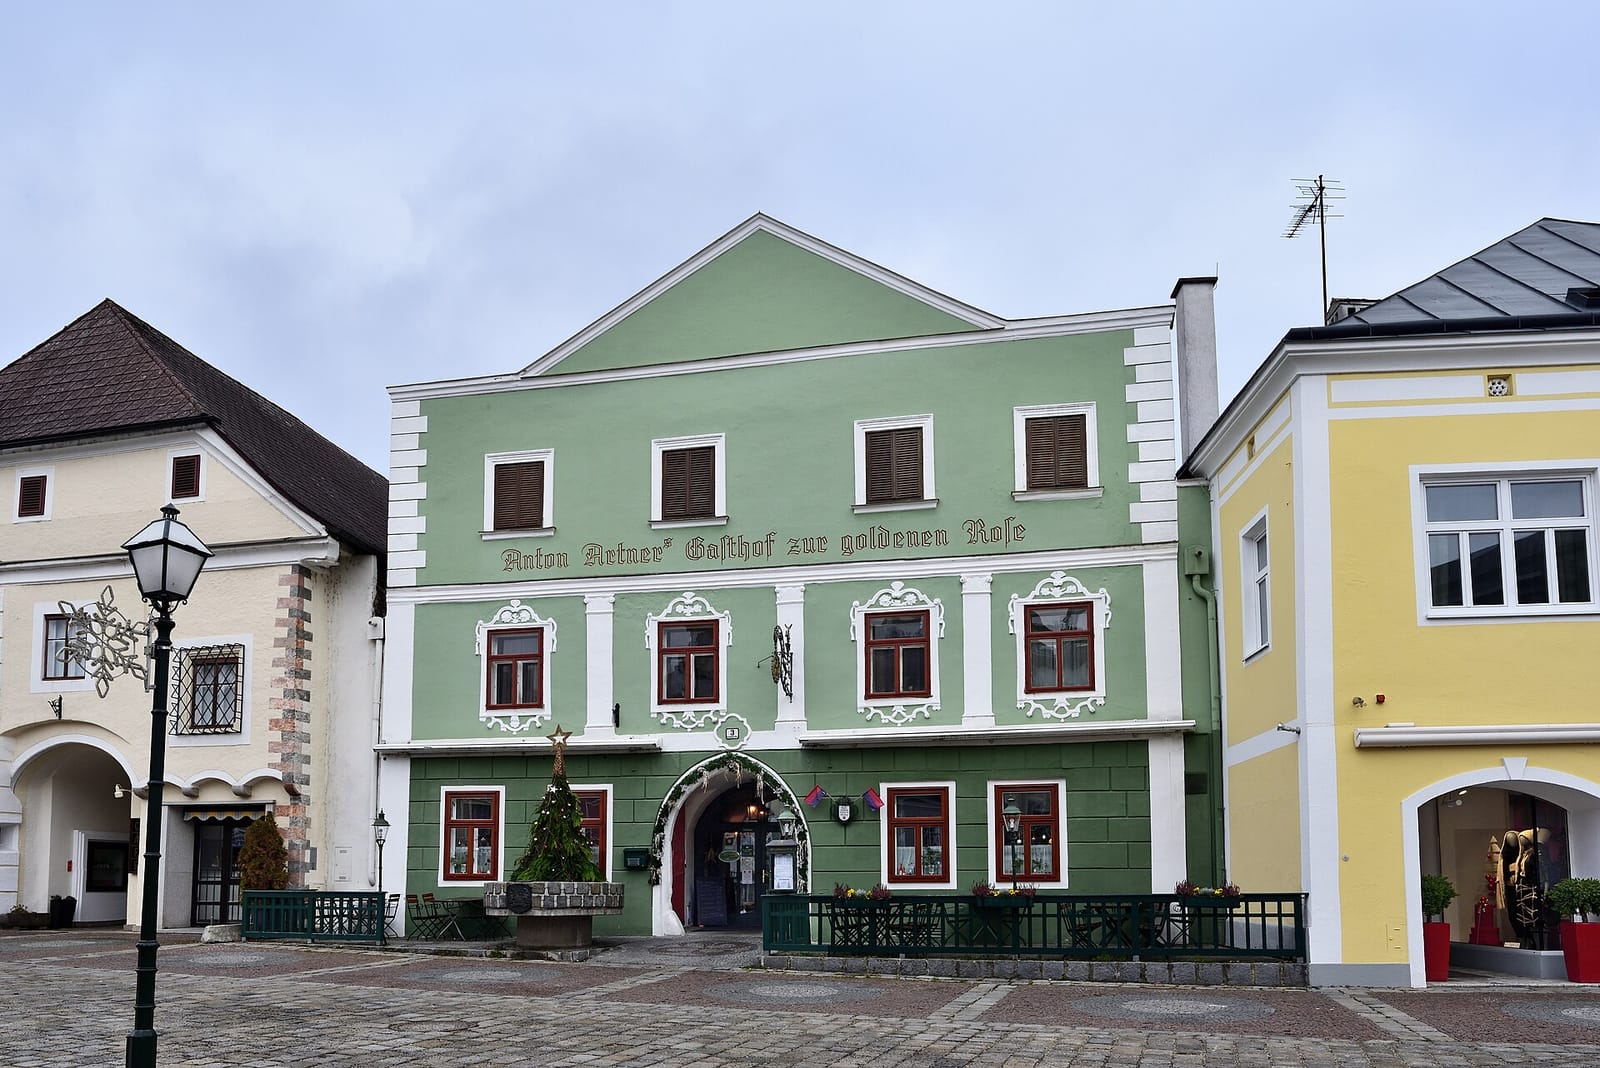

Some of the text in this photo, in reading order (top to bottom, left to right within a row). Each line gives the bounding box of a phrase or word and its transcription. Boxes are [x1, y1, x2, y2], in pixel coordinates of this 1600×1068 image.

[501, 547, 569, 572] Anton
[786, 534, 828, 556] zur
[841, 525, 949, 557] goldenen
